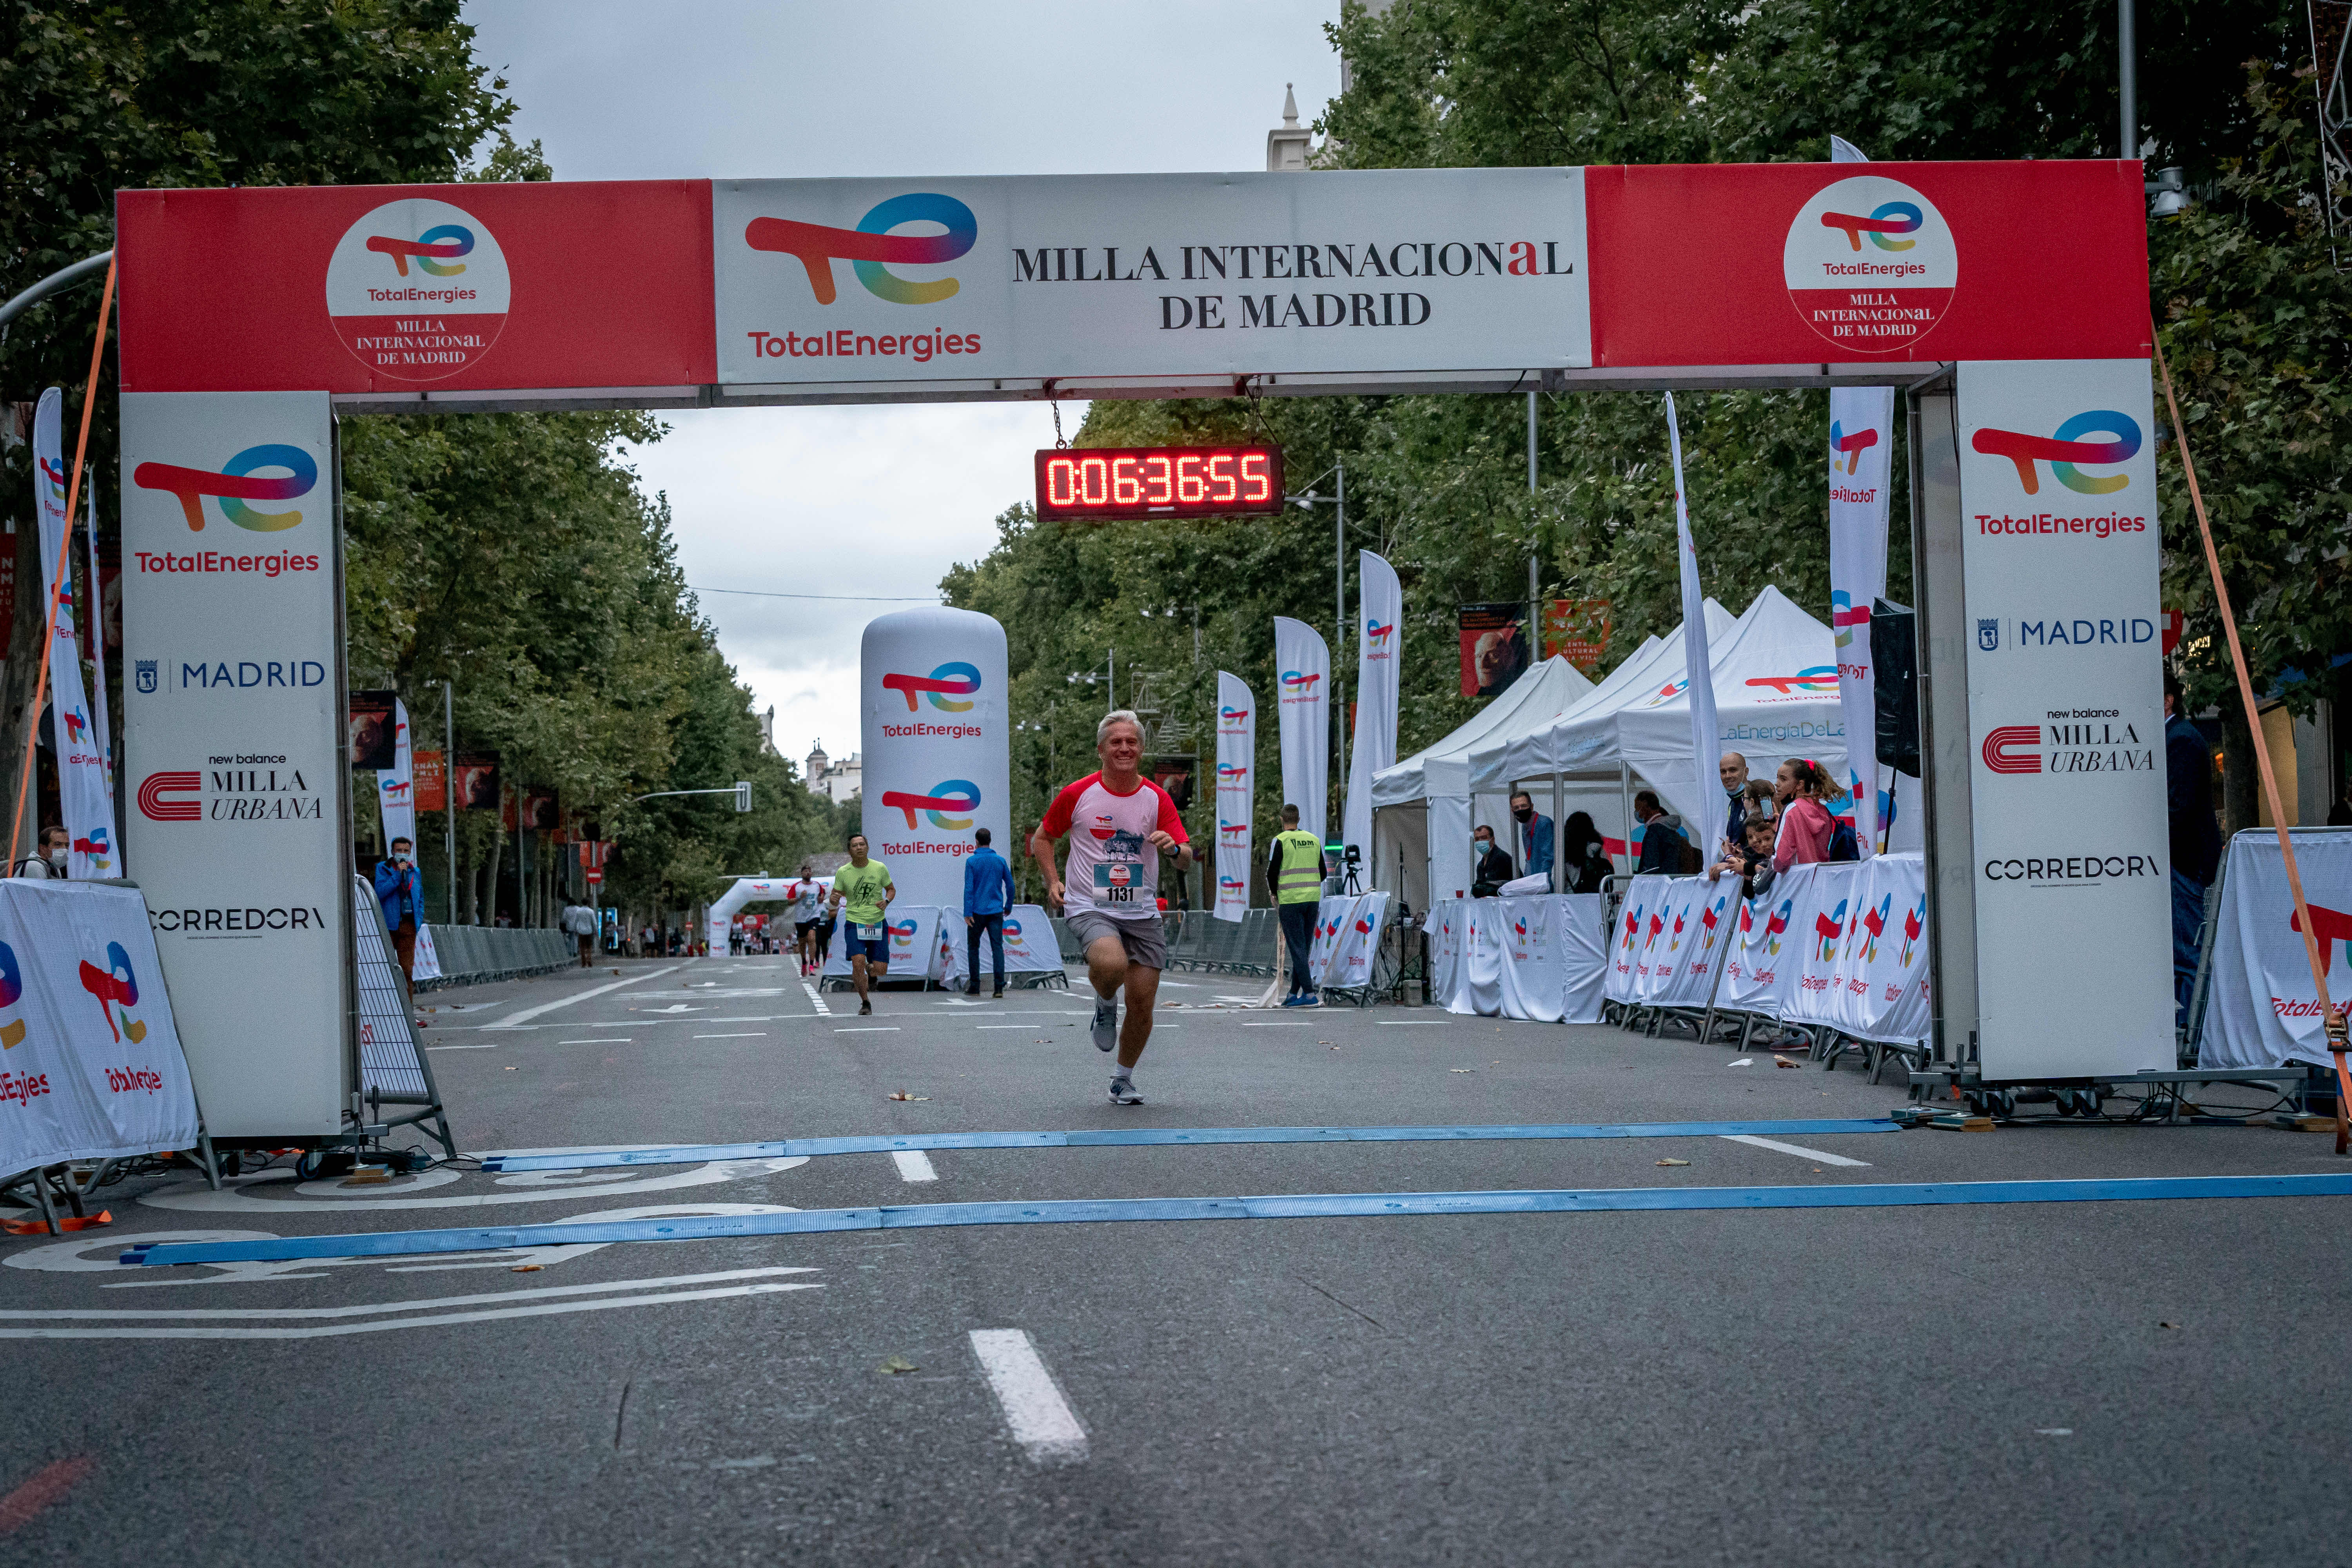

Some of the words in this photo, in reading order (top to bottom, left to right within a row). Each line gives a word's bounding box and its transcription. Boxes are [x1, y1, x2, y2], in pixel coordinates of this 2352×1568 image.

[1012, 246, 1169, 282] MILLA
[1823, 261, 1925, 278] TotalEnergies
[367, 287, 476, 303] TotalEnergies
[1850, 294, 1897, 305] MILLA
[1159, 296, 1225, 329] DE
[1239, 293, 1431, 328] MADRID
[396, 320, 445, 332] MILLA
[1833, 325, 1853, 336] DE
[1858, 324, 1916, 336] MADRID
[748, 327, 981, 362] TotalEnergies
[377, 353, 398, 364] DE
[403, 351, 466, 363] MADRID
[1975, 512, 2145, 538] TotalEnergies
[134, 550, 318, 577] TotalEnergies
[2022, 619, 2154, 645] MADRID
[183, 661, 325, 688] MADRID
[2073, 708, 2119, 718] balance
[881, 723, 981, 739] TotalEnergies
[2051, 724, 2139, 745] MILLA
[209, 756, 233, 764] new
[236, 754, 286, 764] balance
[2051, 750, 2155, 772] URBANA
[212, 770, 307, 791] MILLA
[211, 798, 324, 820] URBANA
[1107, 887, 1133, 902] 1131
